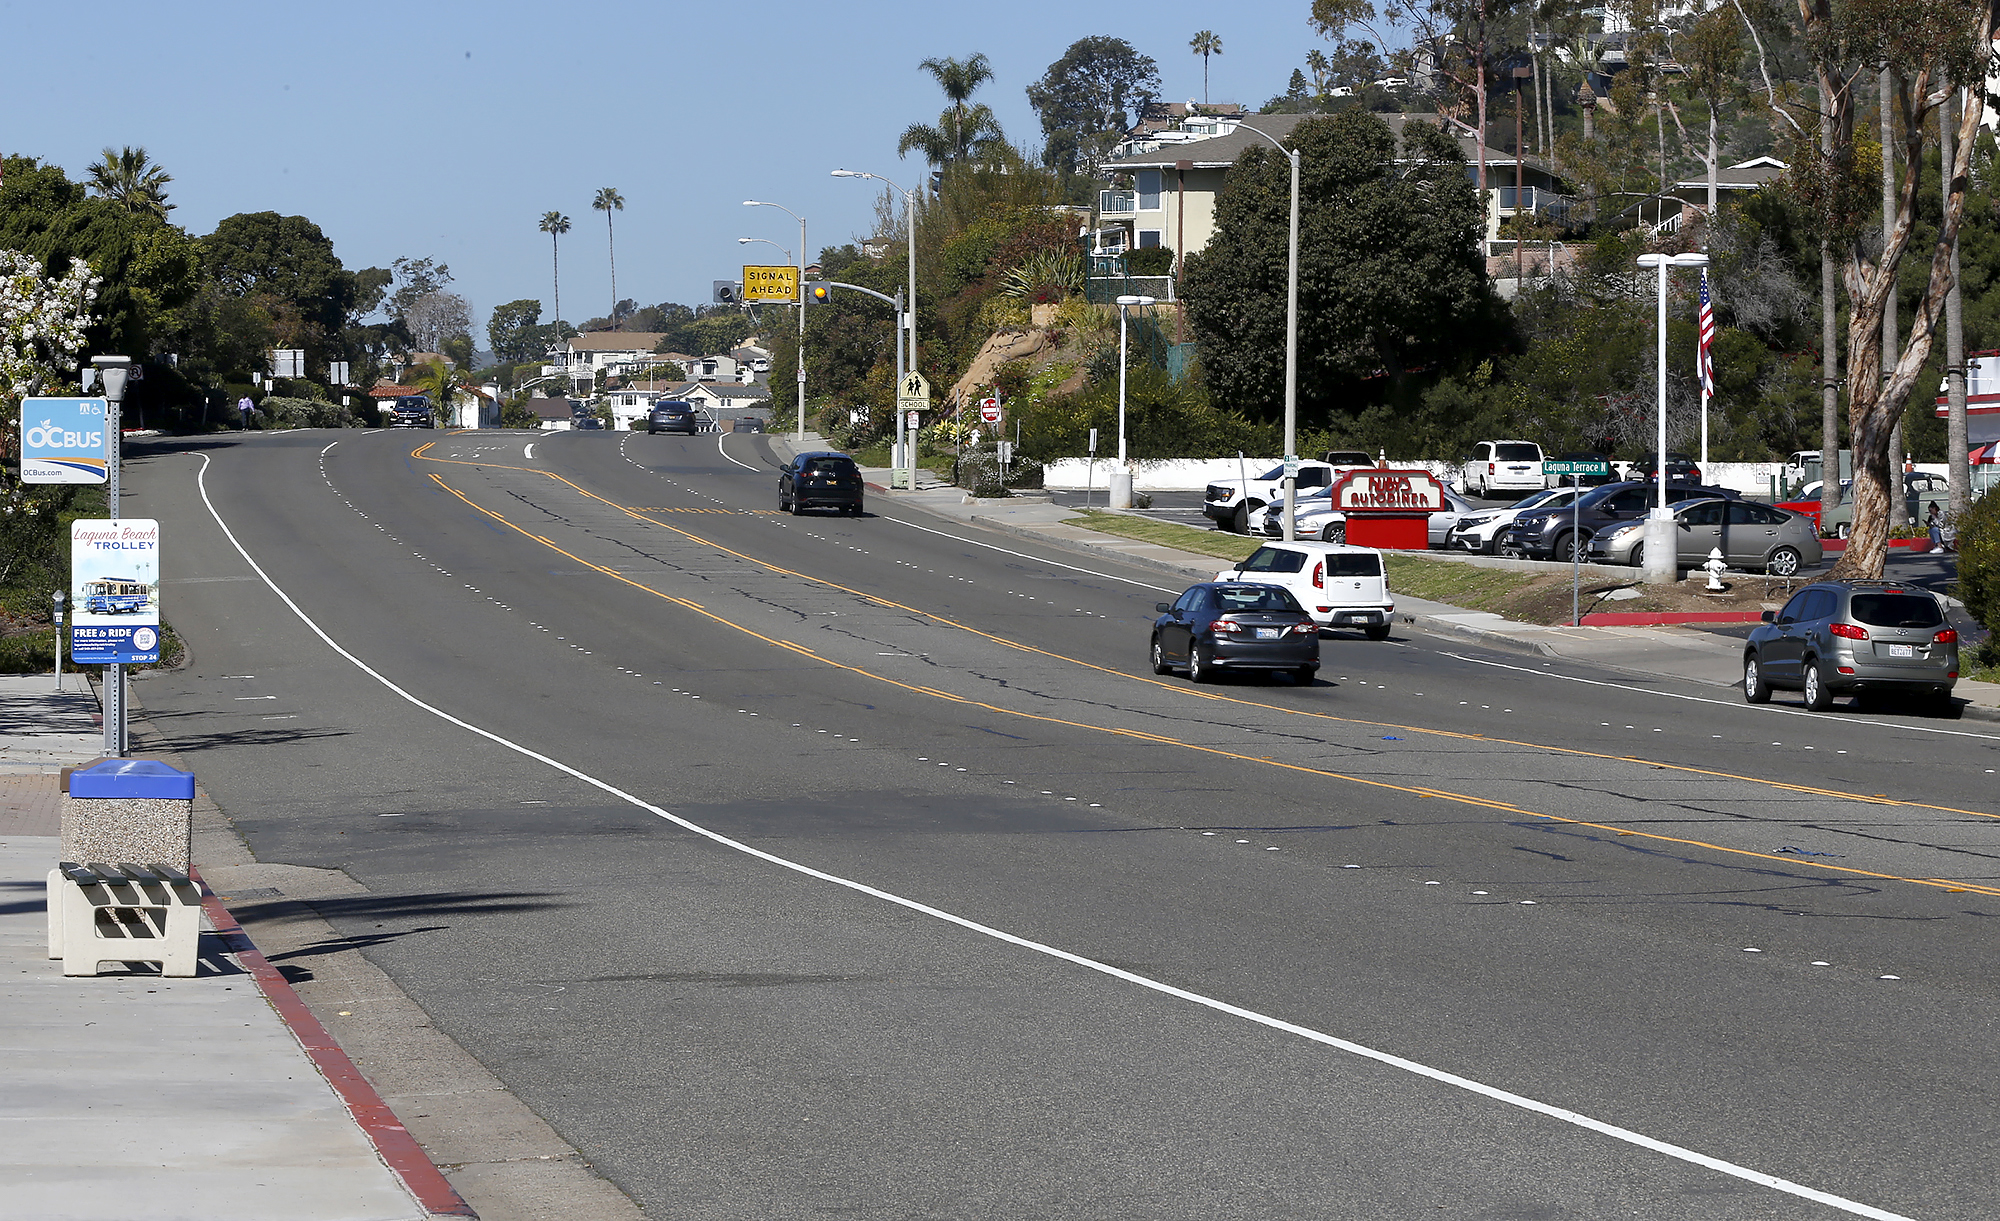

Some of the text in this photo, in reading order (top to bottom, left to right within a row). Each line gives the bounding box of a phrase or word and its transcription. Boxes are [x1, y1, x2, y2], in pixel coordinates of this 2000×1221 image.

[749, 272, 792, 281] SIGNAL
[750, 286, 792, 294] AHEAD
[1544, 462, 1606, 474] Laguna Terrace N
[1351, 492, 1428, 504] AUTODINER
[73, 527, 157, 546] Laguna Beach
[93, 541, 155, 550] TROLLEY
[74, 628, 98, 638] FREE
[99, 629, 107, 637] to
[108, 628, 132, 637] RIDE
